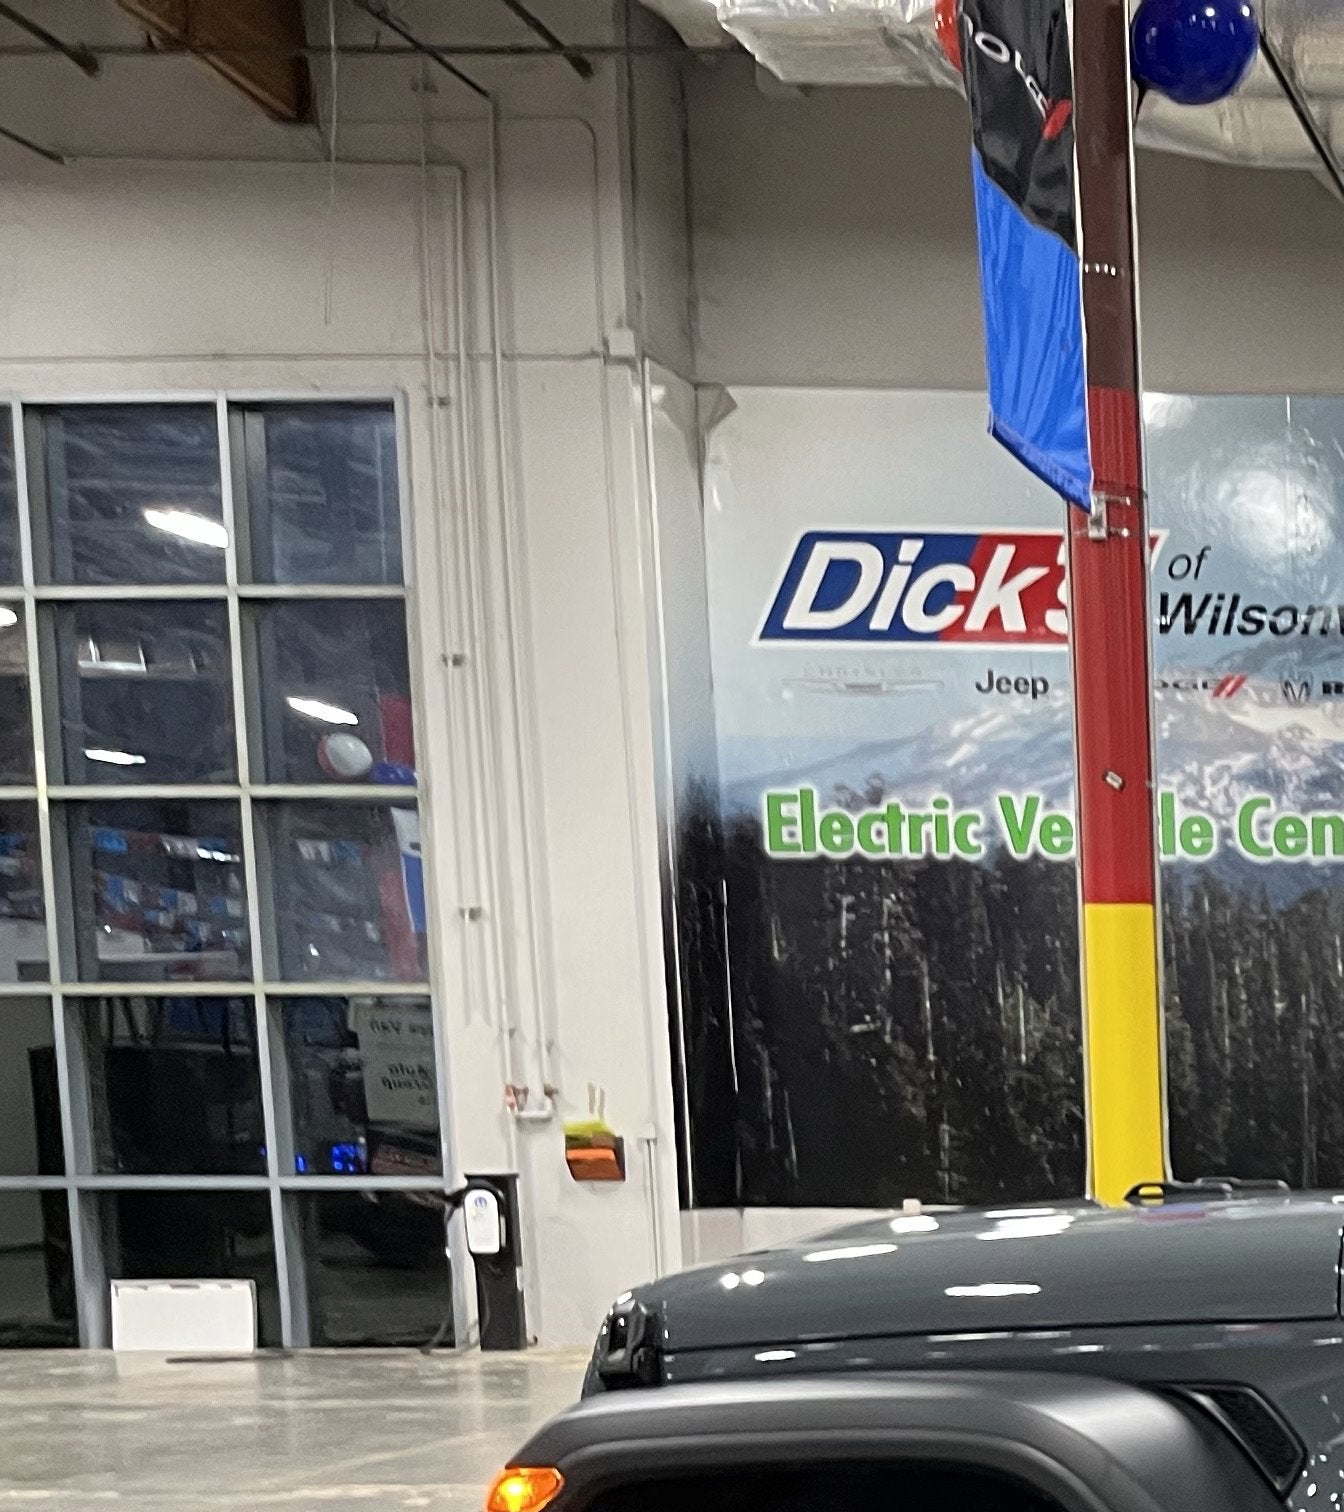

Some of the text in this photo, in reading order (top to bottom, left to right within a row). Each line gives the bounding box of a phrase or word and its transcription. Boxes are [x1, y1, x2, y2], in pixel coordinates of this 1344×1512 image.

[1167, 546, 1211, 580] of
[975, 669, 1050, 700] Jeep
[766, 790, 982, 855] Electric
[998, 791, 1214, 858] Vele
